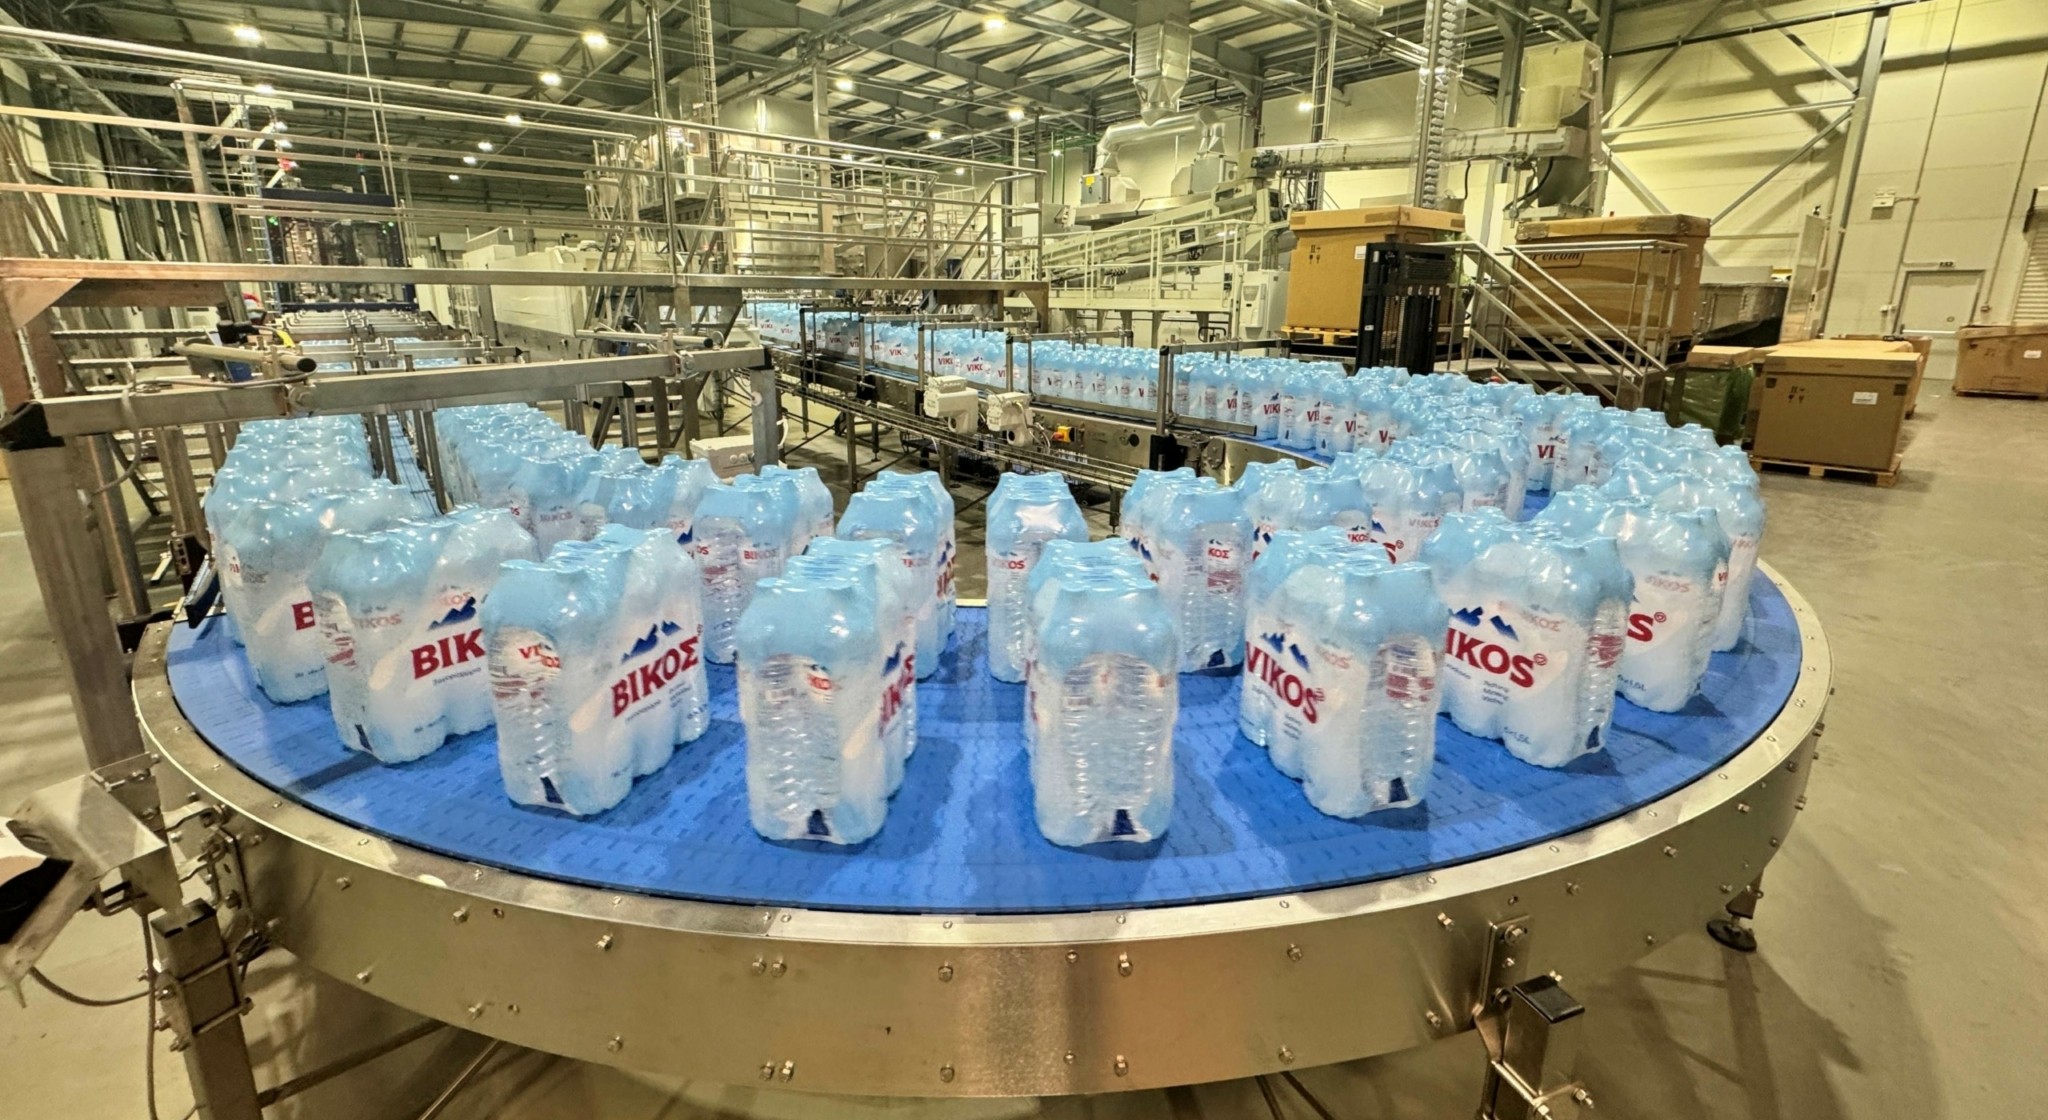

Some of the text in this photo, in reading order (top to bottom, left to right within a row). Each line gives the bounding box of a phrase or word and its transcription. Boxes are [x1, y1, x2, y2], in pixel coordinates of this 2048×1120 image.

[1208, 546, 1230, 559] ΚΟΣ
[410, 628, 486, 680] ΒΙΚ
[611, 636, 699, 717] ΒΙΚΟΣ
[1245, 641, 1318, 724] VIKOS
[1445, 627, 1535, 688] IKOS
